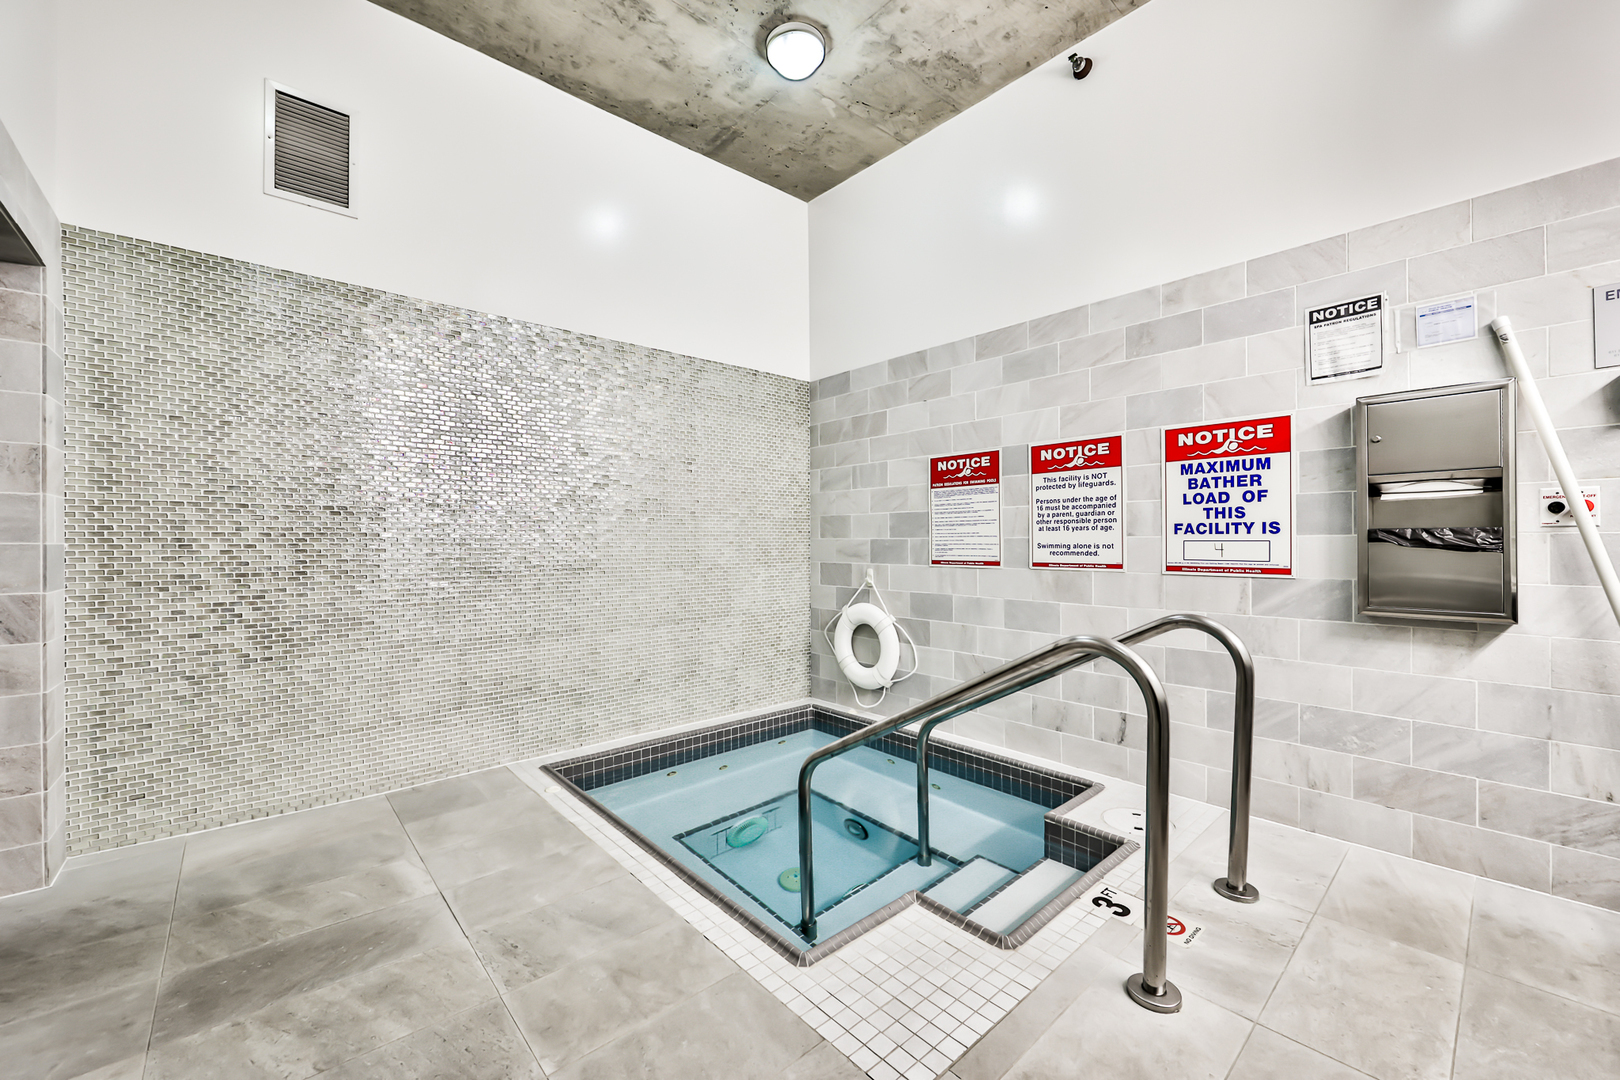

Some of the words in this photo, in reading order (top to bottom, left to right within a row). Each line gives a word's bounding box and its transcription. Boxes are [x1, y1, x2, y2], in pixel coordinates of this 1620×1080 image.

[1312, 298, 1378, 321] NOTICE
[1343, 313, 1376, 323] REGULATIONS
[1178, 424, 1274, 446] NOTICE
[1040, 442, 1110, 461] NOTICE
[938, 456, 990, 471] NOTICE
[1180, 457, 1271, 475] MAXIMUM
[1036, 483, 1066, 492] protected
[1078, 480, 1116, 488] lifeguards.
[1188, 474, 1262, 490] BATHER
[1183, 491, 1230, 505] LOAD
[1242, 490, 1268, 502] OF
[1072, 502, 1116, 512] accompanied
[1203, 506, 1246, 519] THIS
[1174, 522, 1255, 535] FACILITY
[1262, 521, 1281, 534] IS
[1214, 542, 1224, 558] 4
[1100, 887, 1117, 899] FT
[1092, 896, 1131, 917] 3
[1190, 927, 1202, 939] DIVING
